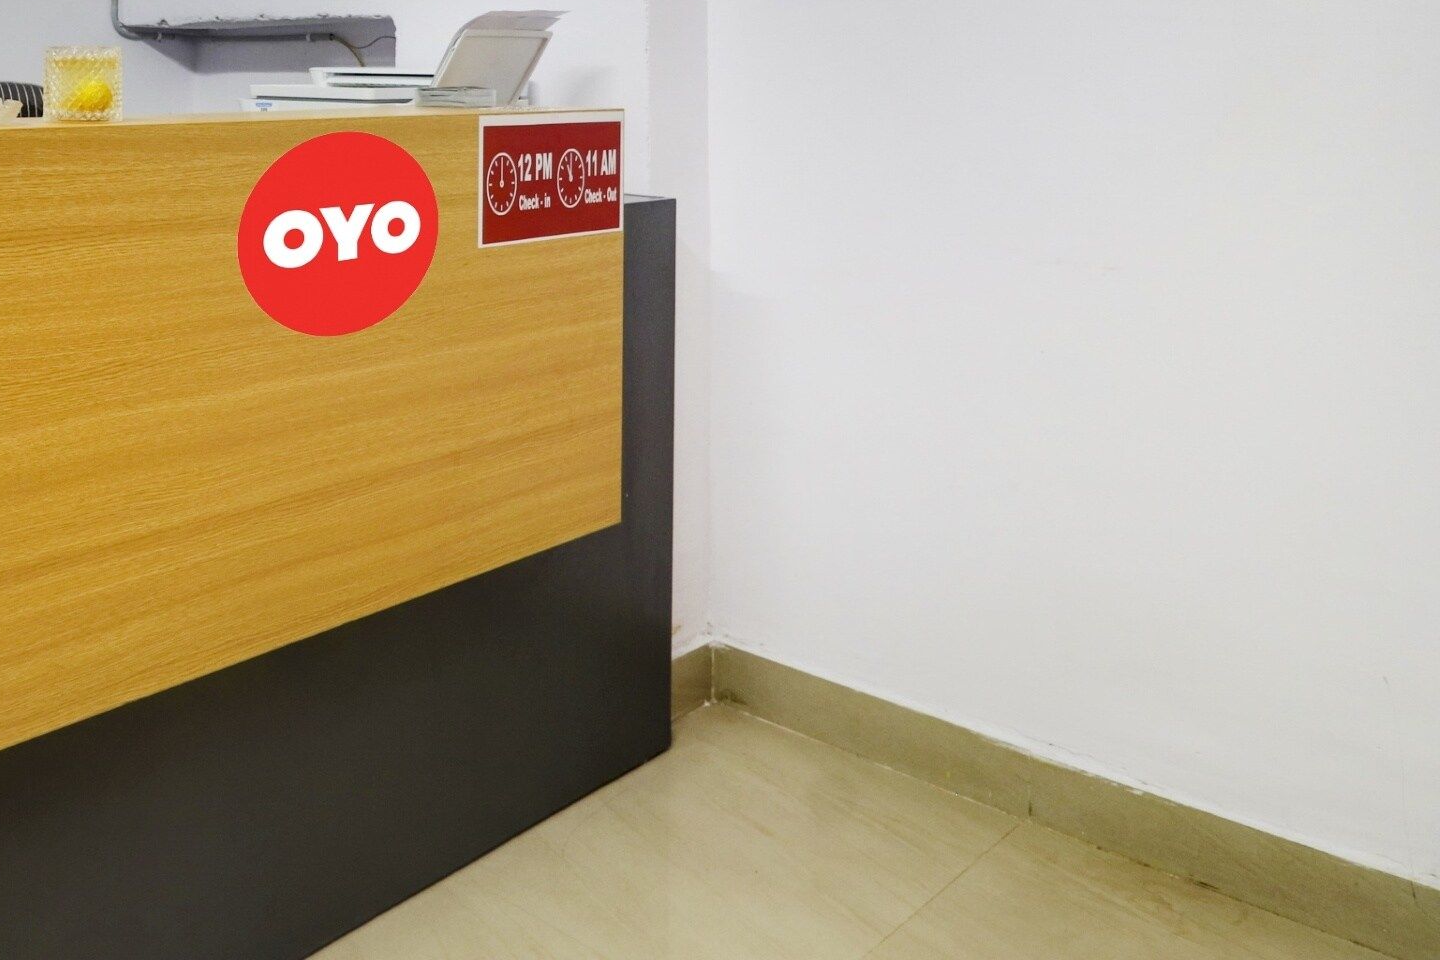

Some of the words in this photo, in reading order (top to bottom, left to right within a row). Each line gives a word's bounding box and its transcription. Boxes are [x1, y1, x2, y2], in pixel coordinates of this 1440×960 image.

[518, 153, 532, 182] 12
[535, 152, 553, 181] PM
[586, 149, 598, 177] 11
[600, 149, 617, 176] AM
[519, 193, 540, 211] Check
[584, 187, 603, 204] Check
[606, 186, 617, 202] Out
[263, 200, 422, 269] OYO
